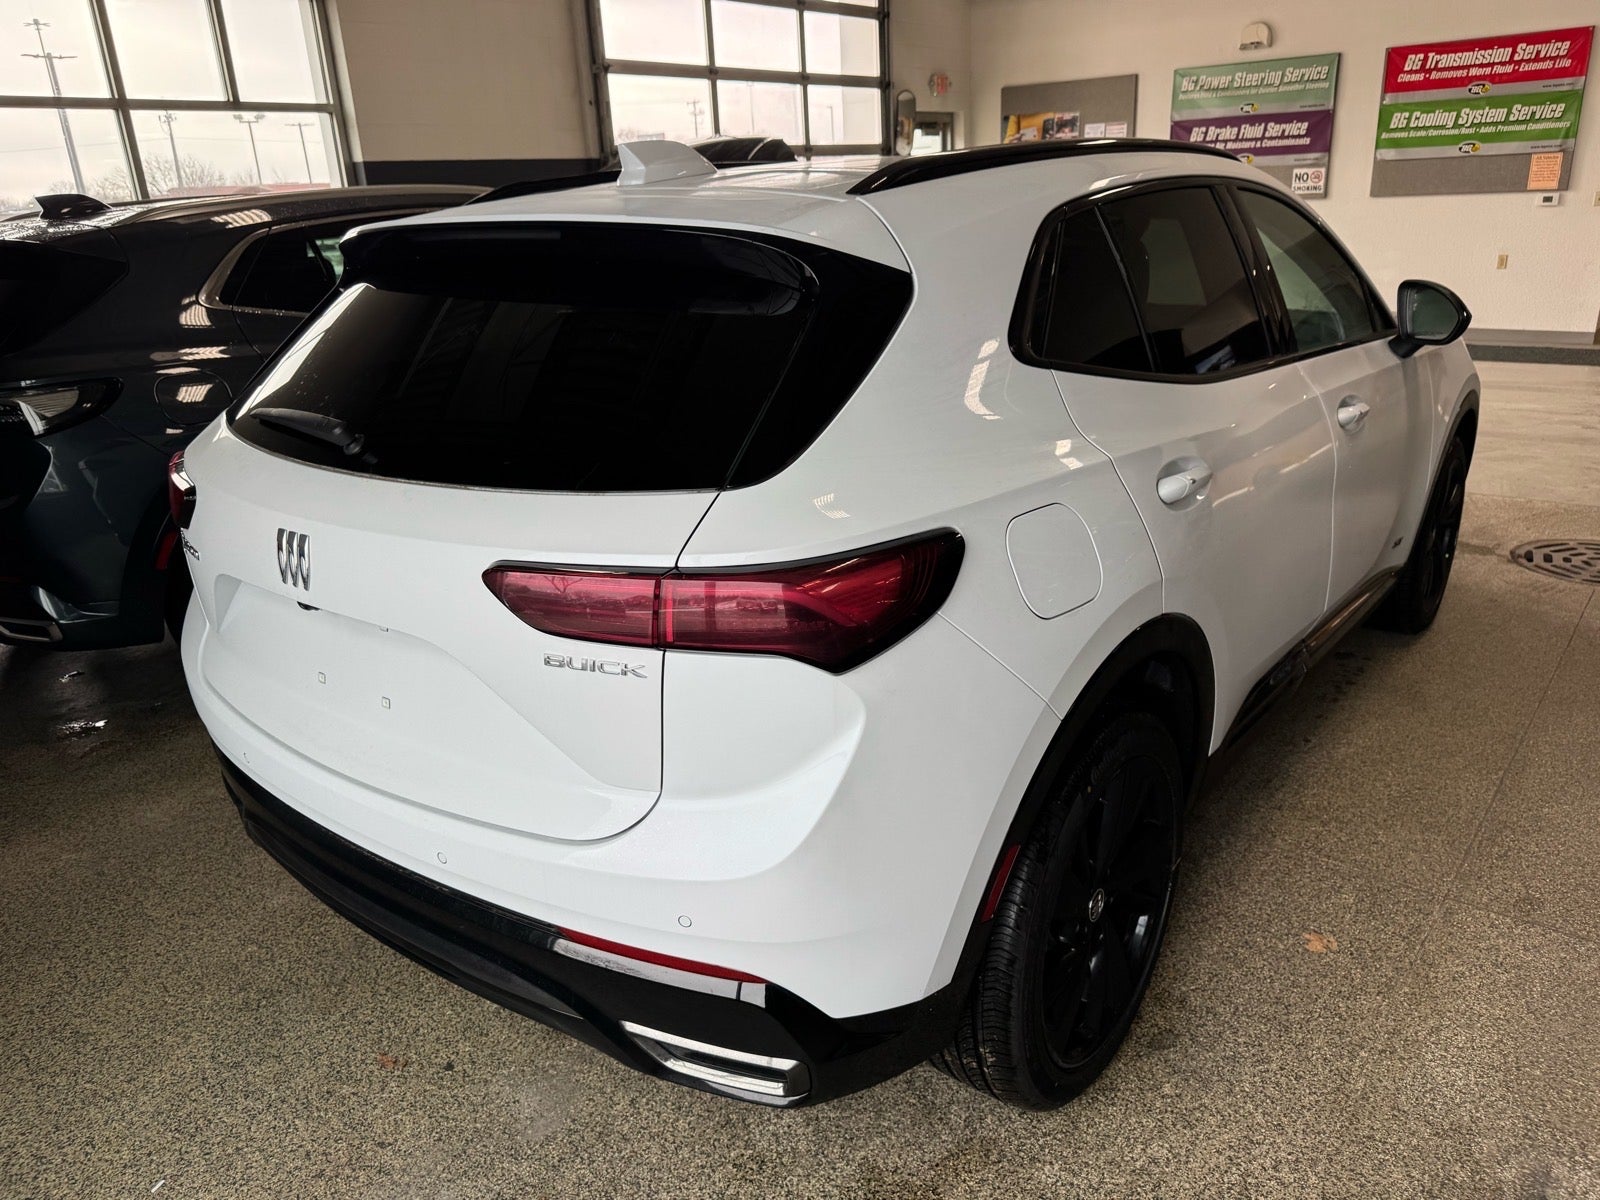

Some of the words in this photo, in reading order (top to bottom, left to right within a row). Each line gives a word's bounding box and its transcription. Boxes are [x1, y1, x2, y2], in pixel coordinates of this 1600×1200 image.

[1404, 54, 1424, 71] BG
[1426, 46, 1512, 69] Transmission
[1514, 40, 1571, 61] Service
[1181, 76, 1197, 91] BG
[1197, 73, 1232, 90] Power
[1234, 69, 1283, 88] Steering
[1284, 64, 1329, 83] Service
[1397, 72, 1425, 83] Cleans
[1430, 68, 1468, 80] Removes
[1469, 66, 1491, 77] Worn
[1492, 63, 1514, 74] Fluid
[1519, 60, 1553, 72] Extends
[1555, 57, 1572, 68] Life
[1389, 112, 1409, 129] BG
[1410, 109, 1457, 129] Cooling
[1458, 105, 1508, 127] System
[1509, 101, 1566, 122] Service
[1190, 127, 1206, 142] BG
[1206, 125, 1238, 141] Brake
[1239, 123, 1264, 139] Fluid
[1265, 120, 1309, 137] Service
[1381, 131, 1409, 139] Removes
[1479, 125, 1496, 133] Adds
[1496, 123, 1527, 132] Premium
[1527, 121, 1571, 130] Conditioners
[1226, 140, 1255, 149] Moisture
[1262, 137, 1311, 147] Contaminants
[1293, 184, 1322, 192] SMOKING
[1294, 172, 1309, 183] NO
[543, 653, 648, 679] BUICK
